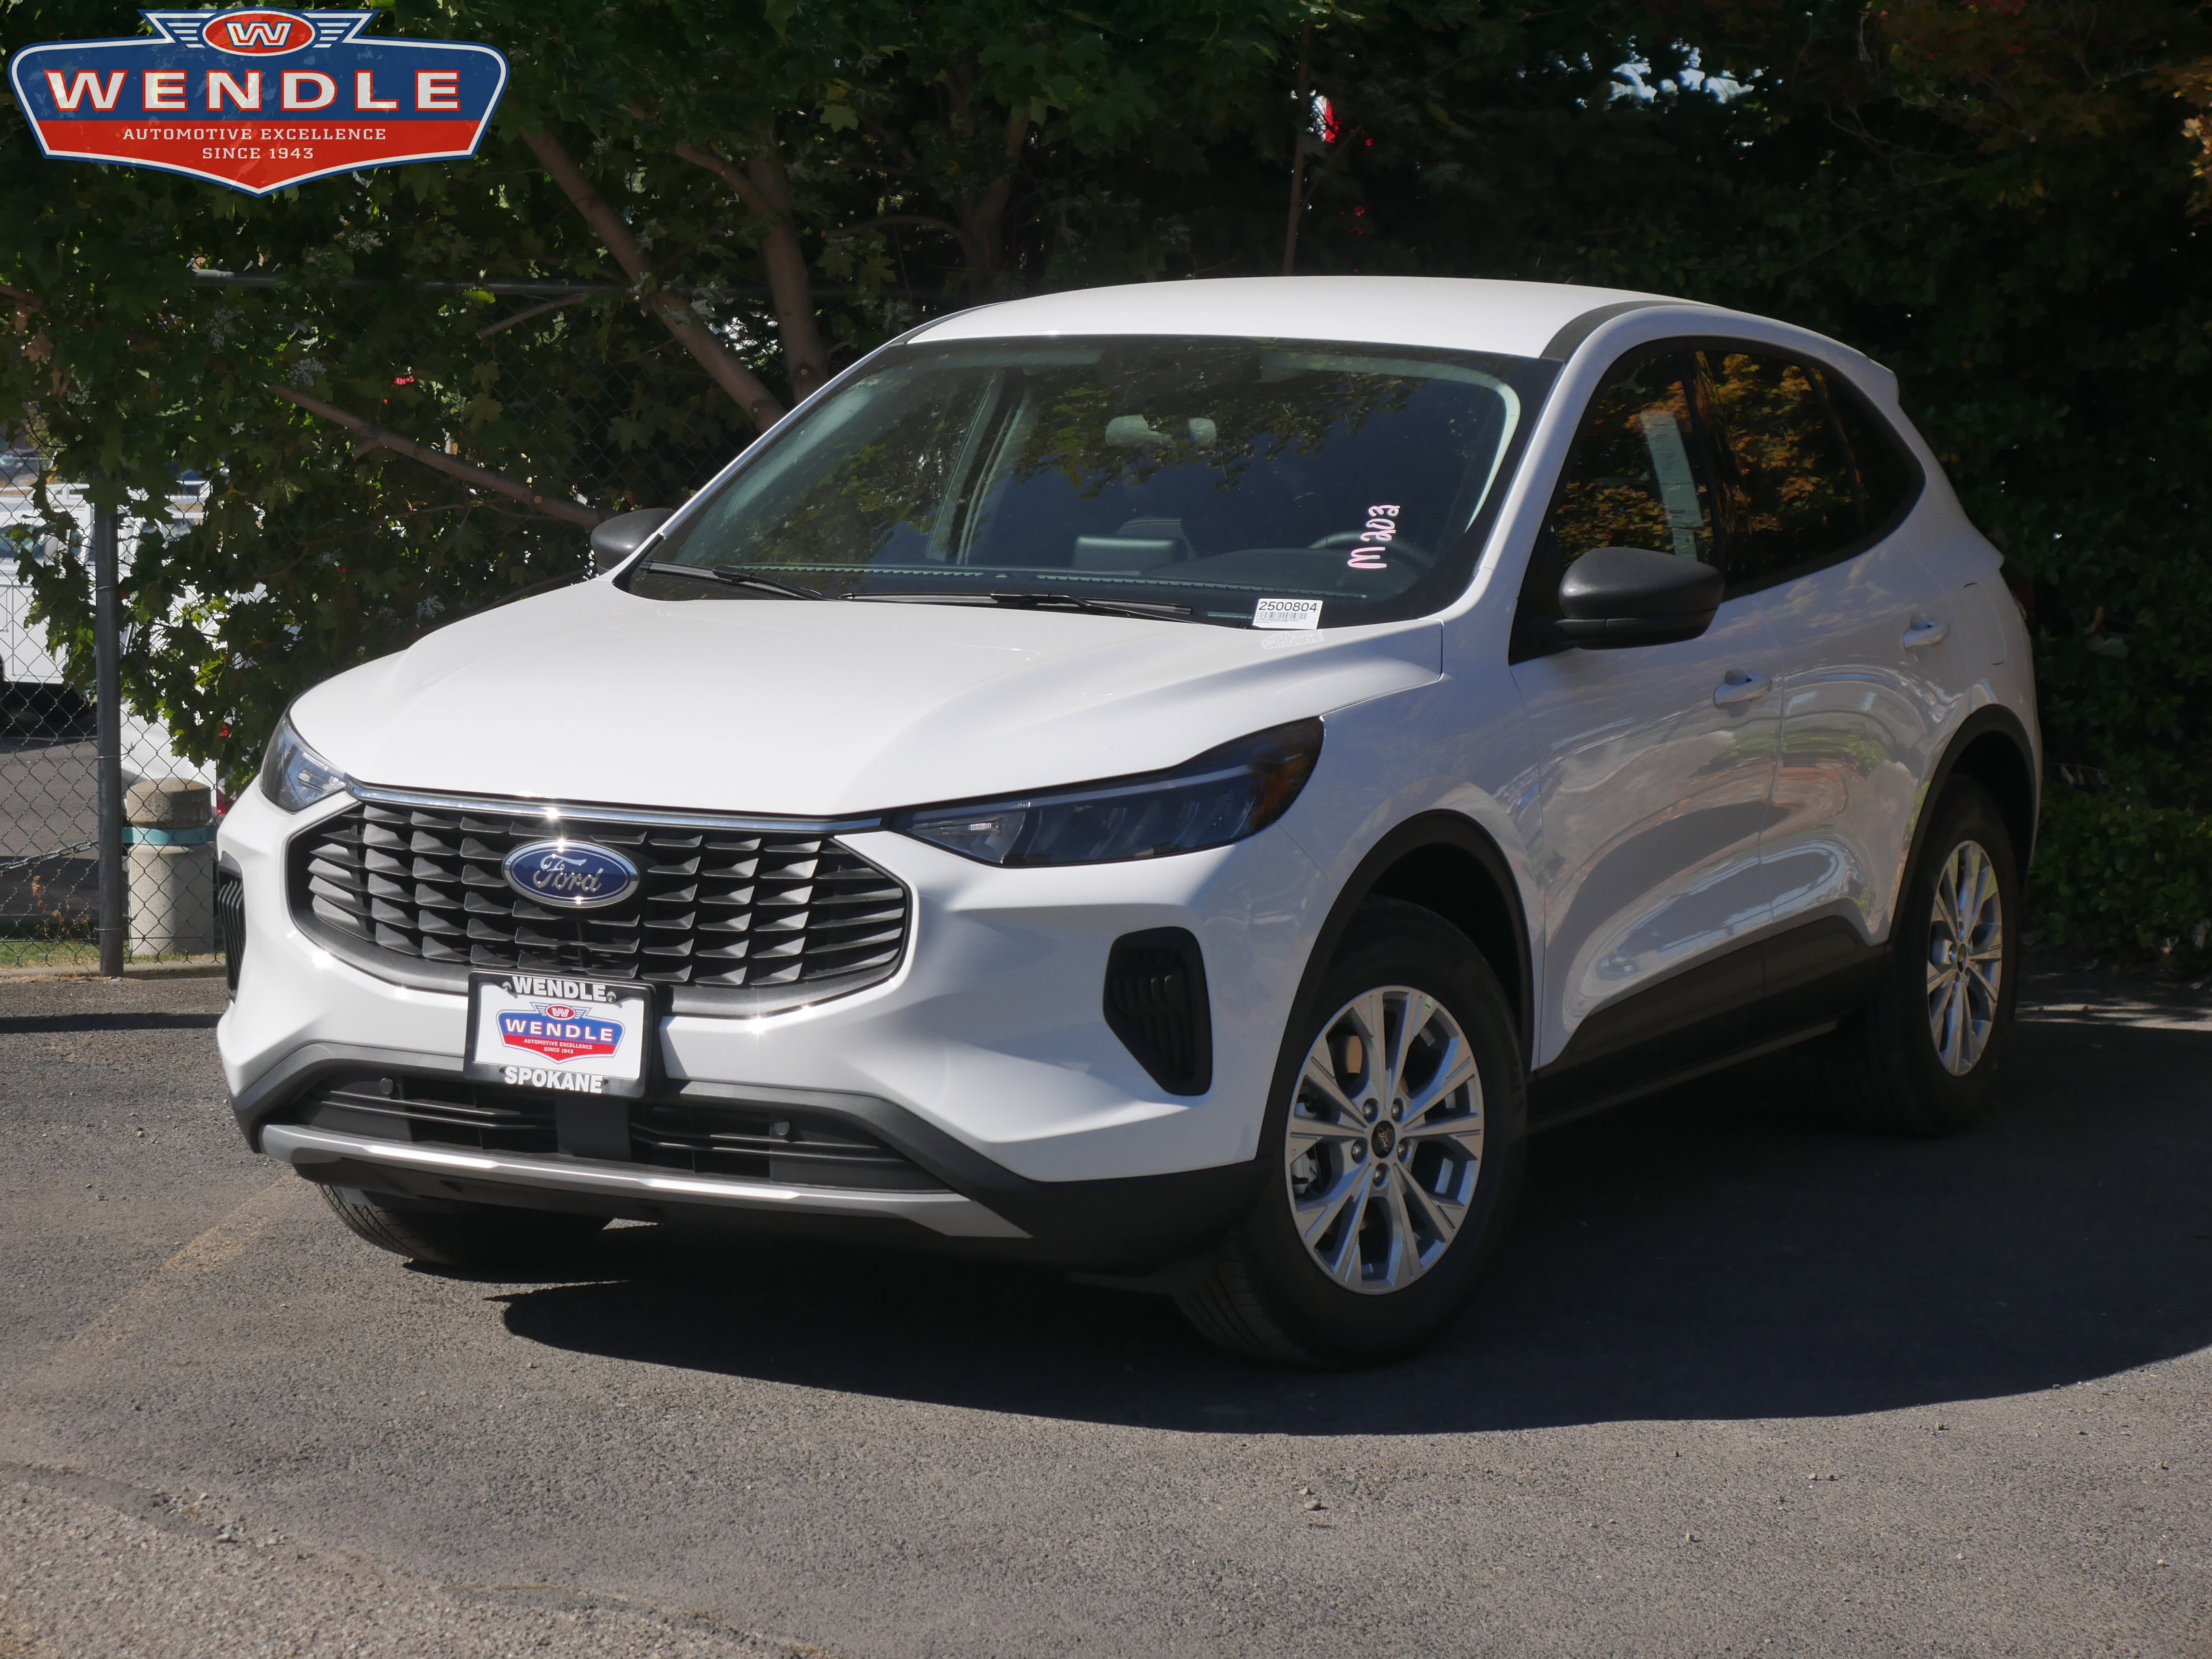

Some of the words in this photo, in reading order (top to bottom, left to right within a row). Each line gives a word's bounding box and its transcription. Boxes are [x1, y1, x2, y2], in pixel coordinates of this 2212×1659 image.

[1258, 601, 1317, 612] 2500804
[532, 855, 604, 893] Ford
[512, 976, 607, 1003] WENDLE
[505, 1018, 613, 1042] WENDLE
[524, 1038, 558, 1046] AUTOMOTIVE
[559, 1042, 593, 1050] EXCELLENCE
[504, 1066, 603, 1094] SPOKANE
